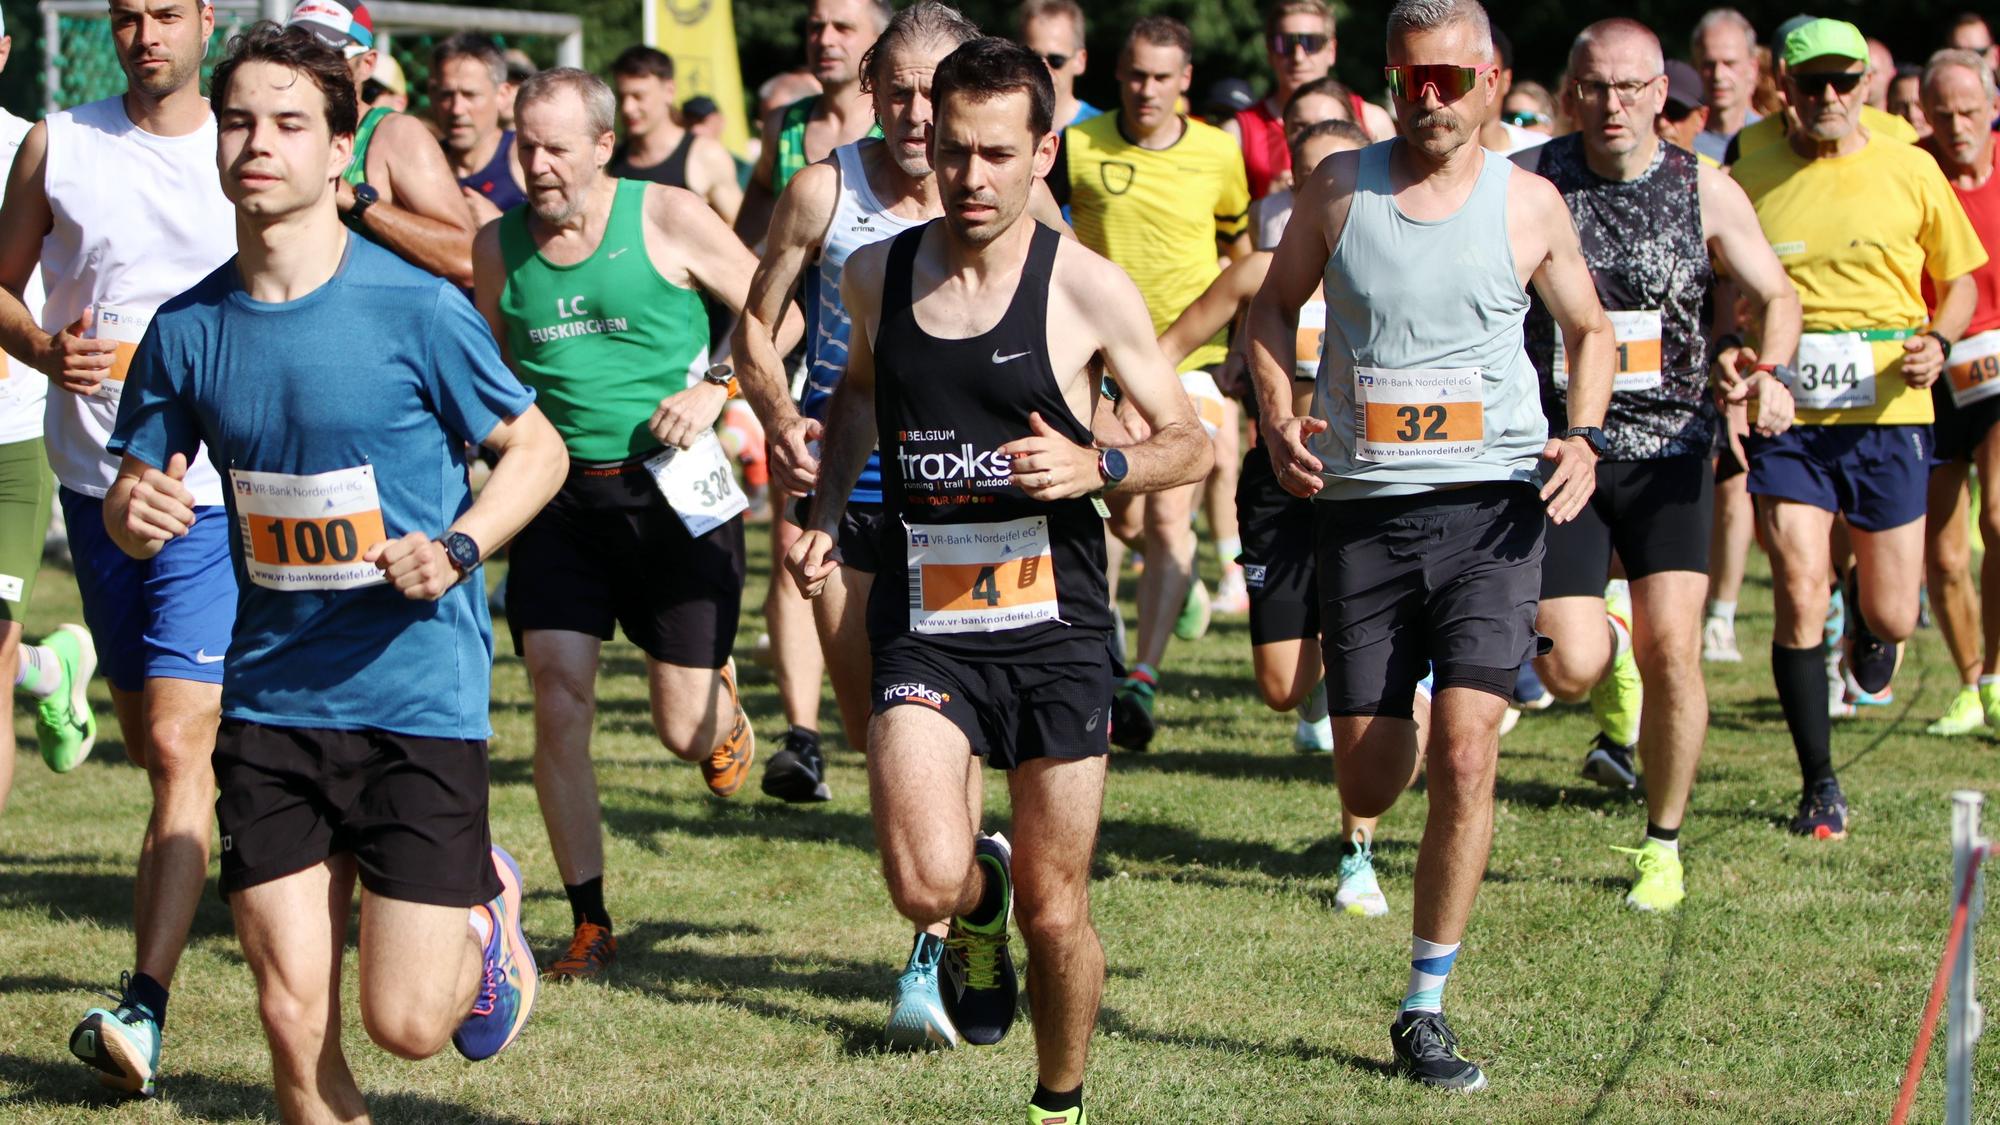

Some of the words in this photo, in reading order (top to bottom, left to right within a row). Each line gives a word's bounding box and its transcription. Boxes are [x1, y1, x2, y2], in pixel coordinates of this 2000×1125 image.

[851, 225, 876, 233] erima
[557, 295, 589, 319] LC
[121, 315, 147, 327] VR-Ba
[529, 317, 628, 343] EUSKIRCHEN
[1615, 342, 1628, 372] 1
[1375, 376, 1413, 388] VR-Bank
[1415, 376, 1457, 387] Nordeifel
[1458, 376, 1472, 386] eG
[1801, 362, 1860, 391] 344
[1396, 405, 1448, 442] 32
[907, 429, 956, 441] BELGIUM
[1363, 445, 1476, 457] www.vr-banknordeifel.de
[252, 482, 291, 497] VR-Bank
[293, 482, 344, 498] Nordeifel
[346, 481, 362, 491] eG
[903, 482, 934, 492] running
[943, 479, 964, 489] trail
[267, 518, 358, 564] 100
[930, 534, 973, 546] VR-Bank
[974, 531, 1021, 544] Nordeifel
[1022, 528, 1037, 538] eG
[254, 566, 381, 583] www.vr-banknordeifel.de
[971, 565, 1001, 607] 4
[919, 608, 1050, 627] www.vr-banknordeifel.de
